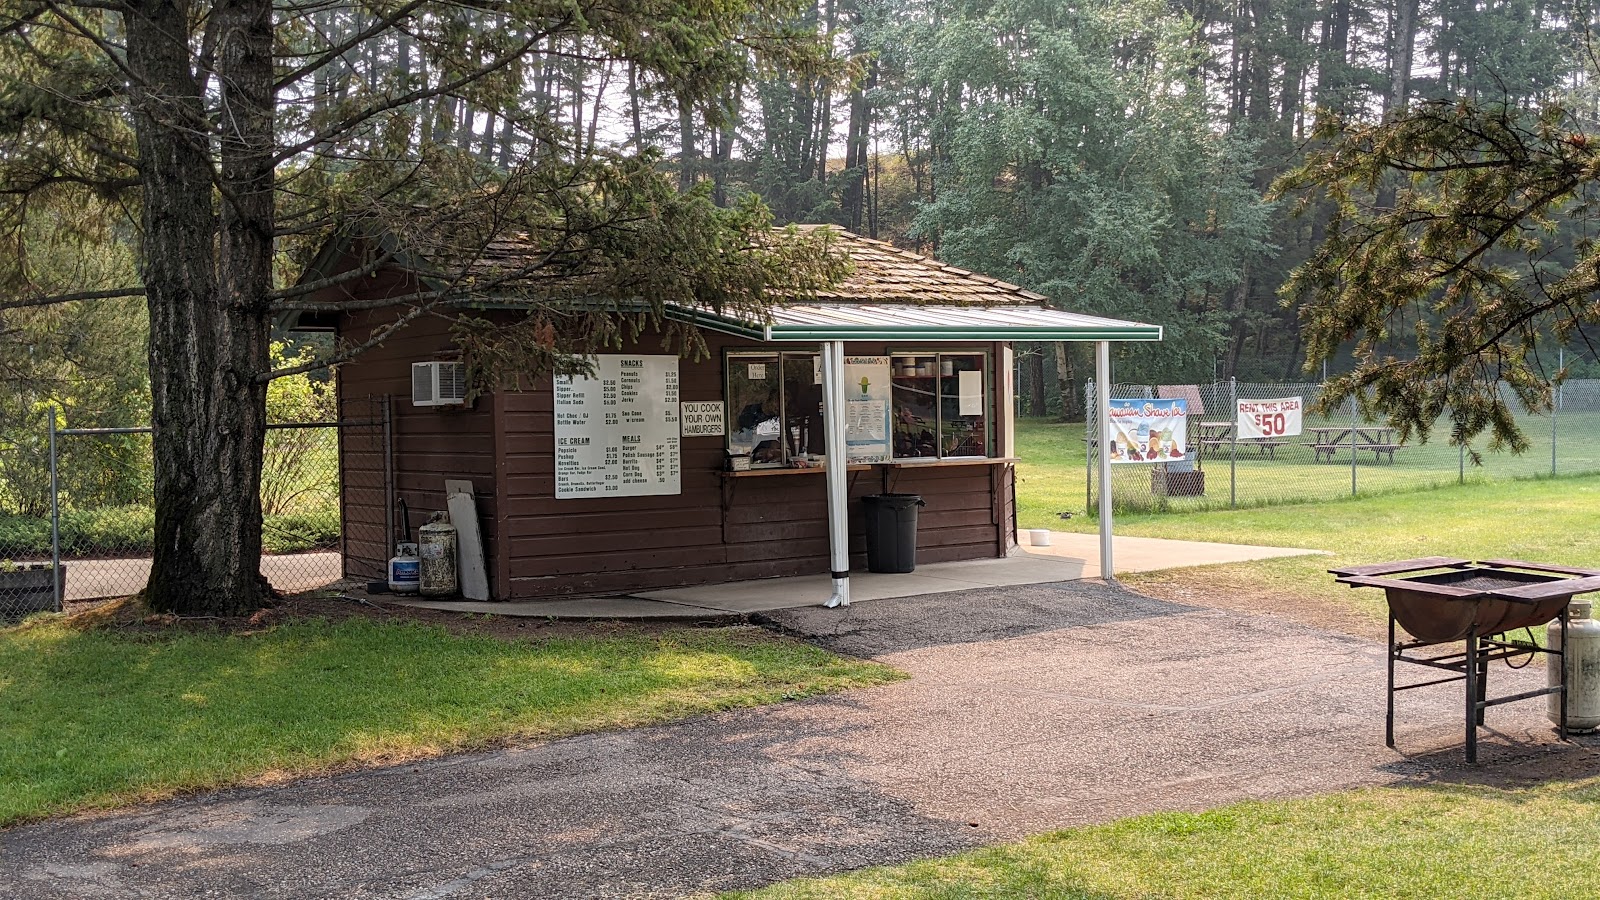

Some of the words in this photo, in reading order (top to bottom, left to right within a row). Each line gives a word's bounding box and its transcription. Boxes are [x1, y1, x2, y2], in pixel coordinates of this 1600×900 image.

[684, 404, 698, 412] YOU
[701, 404, 721, 412] COOK
[1144, 403, 1170, 417] Shave
[1171, 402, 1185, 416] Ice
[1240, 403, 1258, 412] RENT
[1261, 403, 1277, 412] THIS
[1281, 401, 1299, 411] AREA
[684, 414, 702, 423] YOUR
[705, 414, 721, 422] OWN
[1255, 412, 1285, 435] $50
[684, 425, 721, 433] HAMBURGERS
